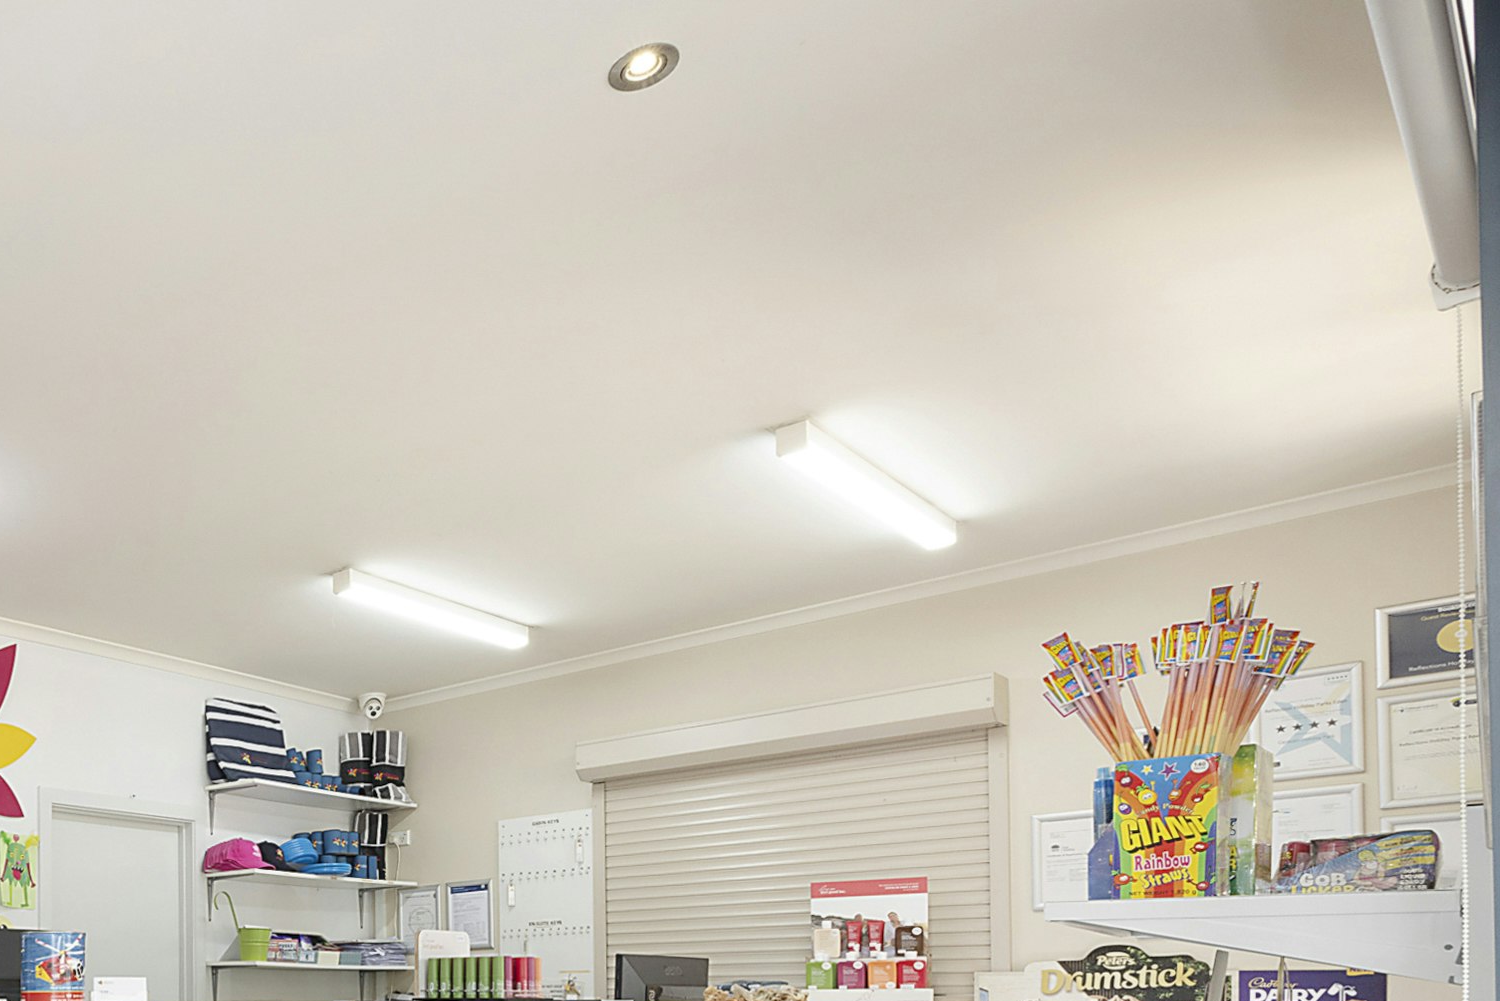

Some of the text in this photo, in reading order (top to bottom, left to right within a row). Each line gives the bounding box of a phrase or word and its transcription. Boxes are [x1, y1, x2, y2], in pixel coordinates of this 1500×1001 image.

[1162, 802, 1195, 816] Powder
[1120, 815, 1208, 853] GIANT
[1134, 851, 1191, 871] Rainbow
[1137, 867, 1192, 890] Straws
[1097, 952, 1136, 967] Peters
[1040, 962, 1198, 996] Drumstick
